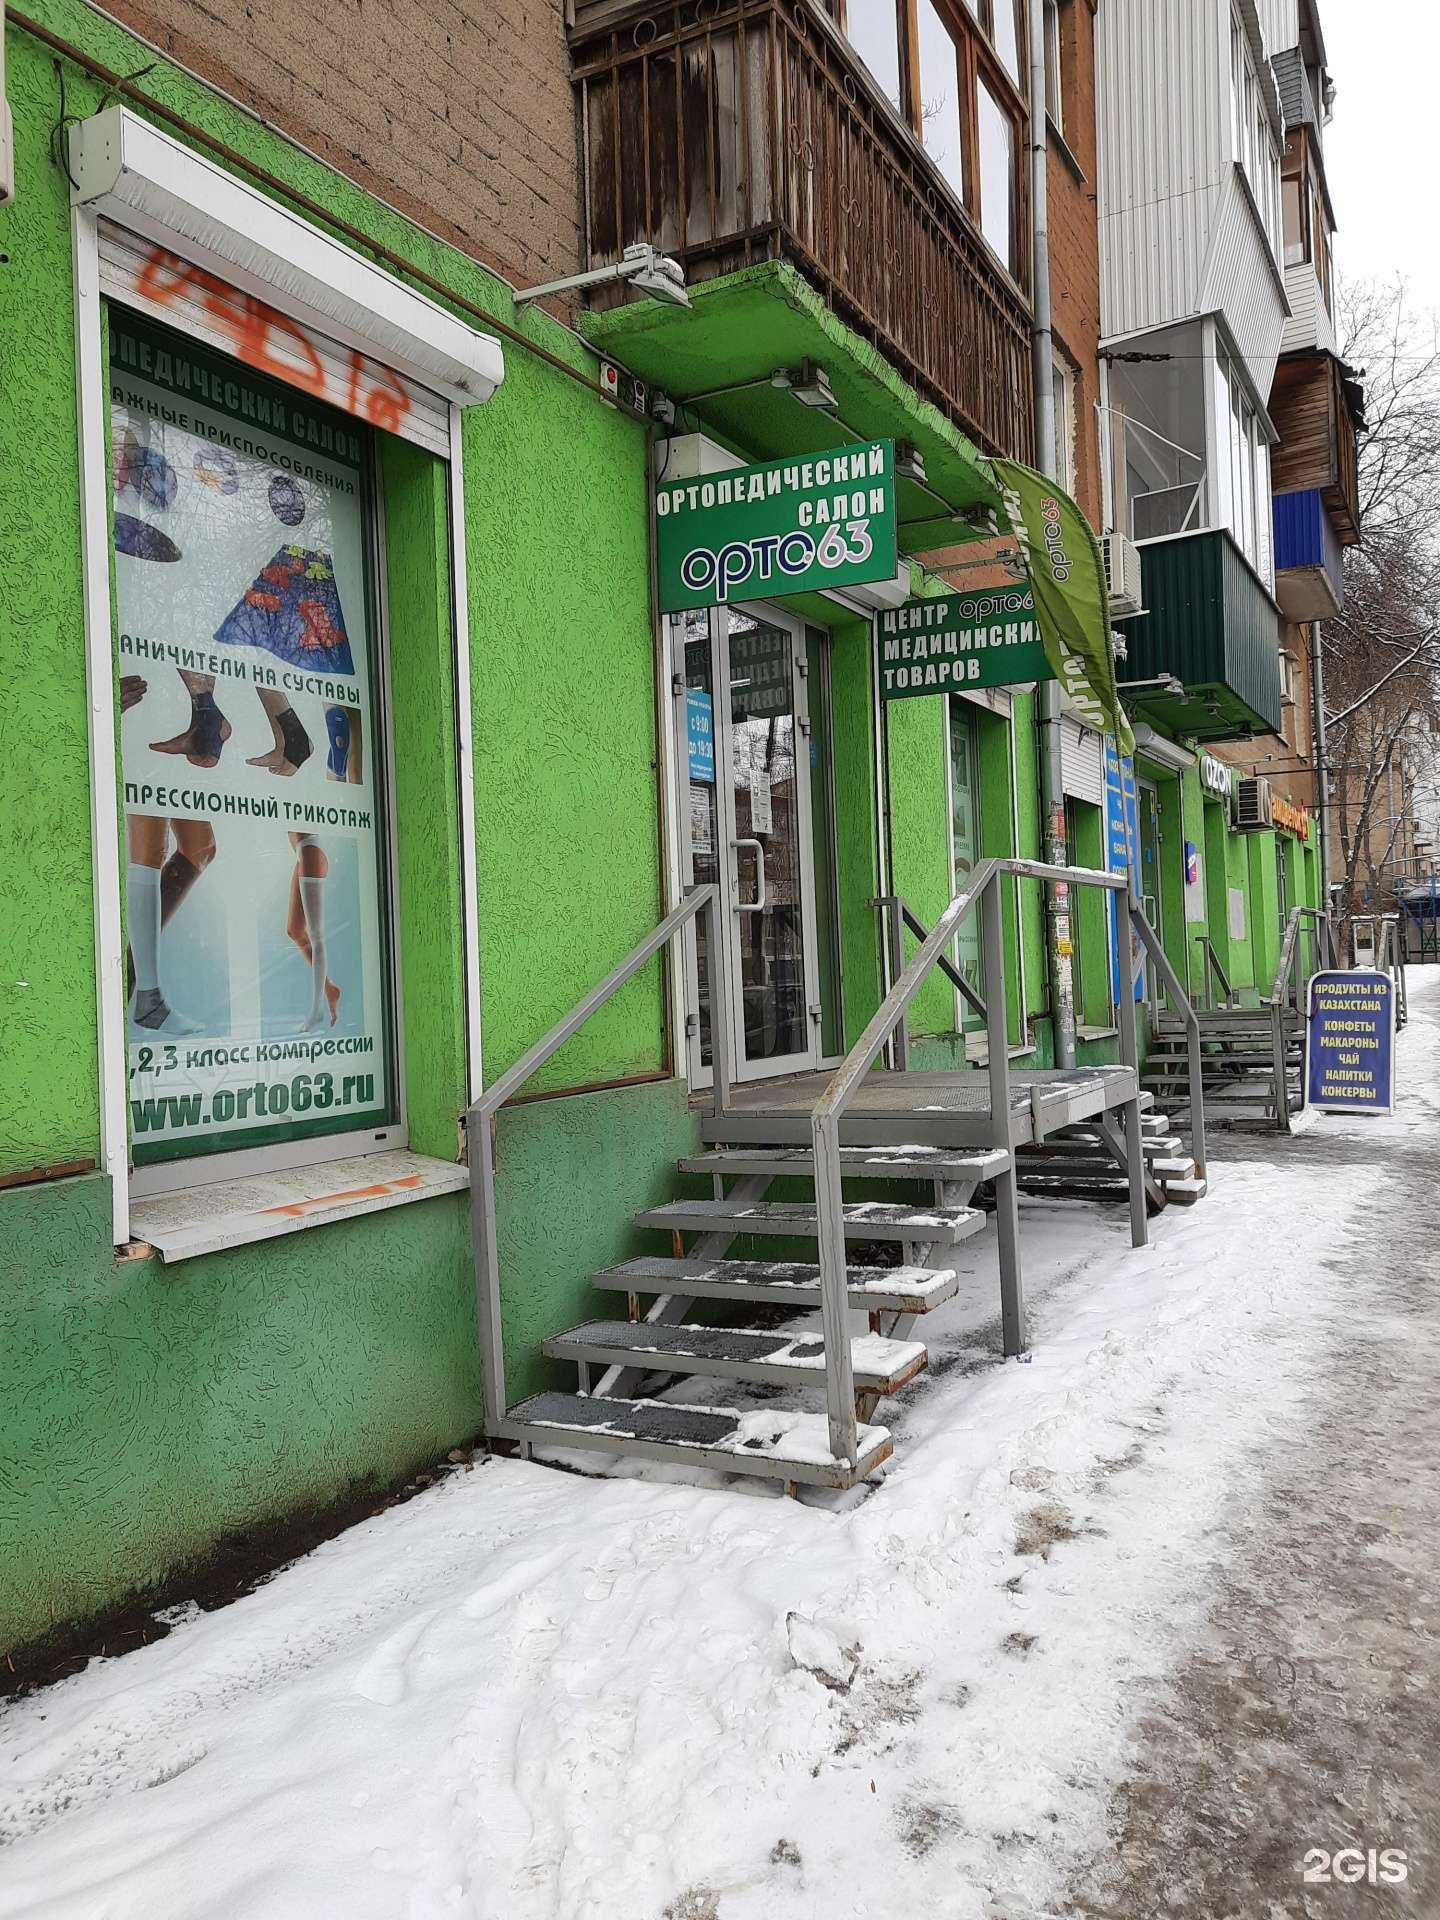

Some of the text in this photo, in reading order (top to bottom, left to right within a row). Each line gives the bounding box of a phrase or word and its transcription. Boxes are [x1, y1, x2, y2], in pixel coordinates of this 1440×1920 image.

[194, 419, 354, 494] ПРИСПОСОБЛЕНИЯ
[656, 444, 884, 516] ОРТОПЕДИЧЕСКИЙ
[798, 487, 885, 527] САЛОН
[884, 603, 949, 634] ЦЕНТР
[120, 634, 360, 704] АНИЧИТЕЛИ НА СУСТАВЫ
[883, 658, 980, 690] ТОВАРОВ
[1201, 755, 1232, 795] OZON
[125, 783, 371, 829] ПРЕССИОННЫЙ ТРИКОТАЖ
[1315, 984, 1387, 995] ПРОДУКТЫ ИЗ
[1320, 1000, 1381, 1011] КАЗАХСТАНА
[1324, 1021, 1375, 1032] КОНФЕТЫ
[186, 1046, 250, 1068] класс
[256, 1037, 373, 1064] компрессии
[1320, 1036, 1379, 1049] МАКАРОНЫ
[1338, 1052, 1359, 1065] ЧАЙ
[1325, 1069, 1372, 1081] НАПИТКИ
[1321, 1085, 1376, 1098] КОНСЕРВЫ
